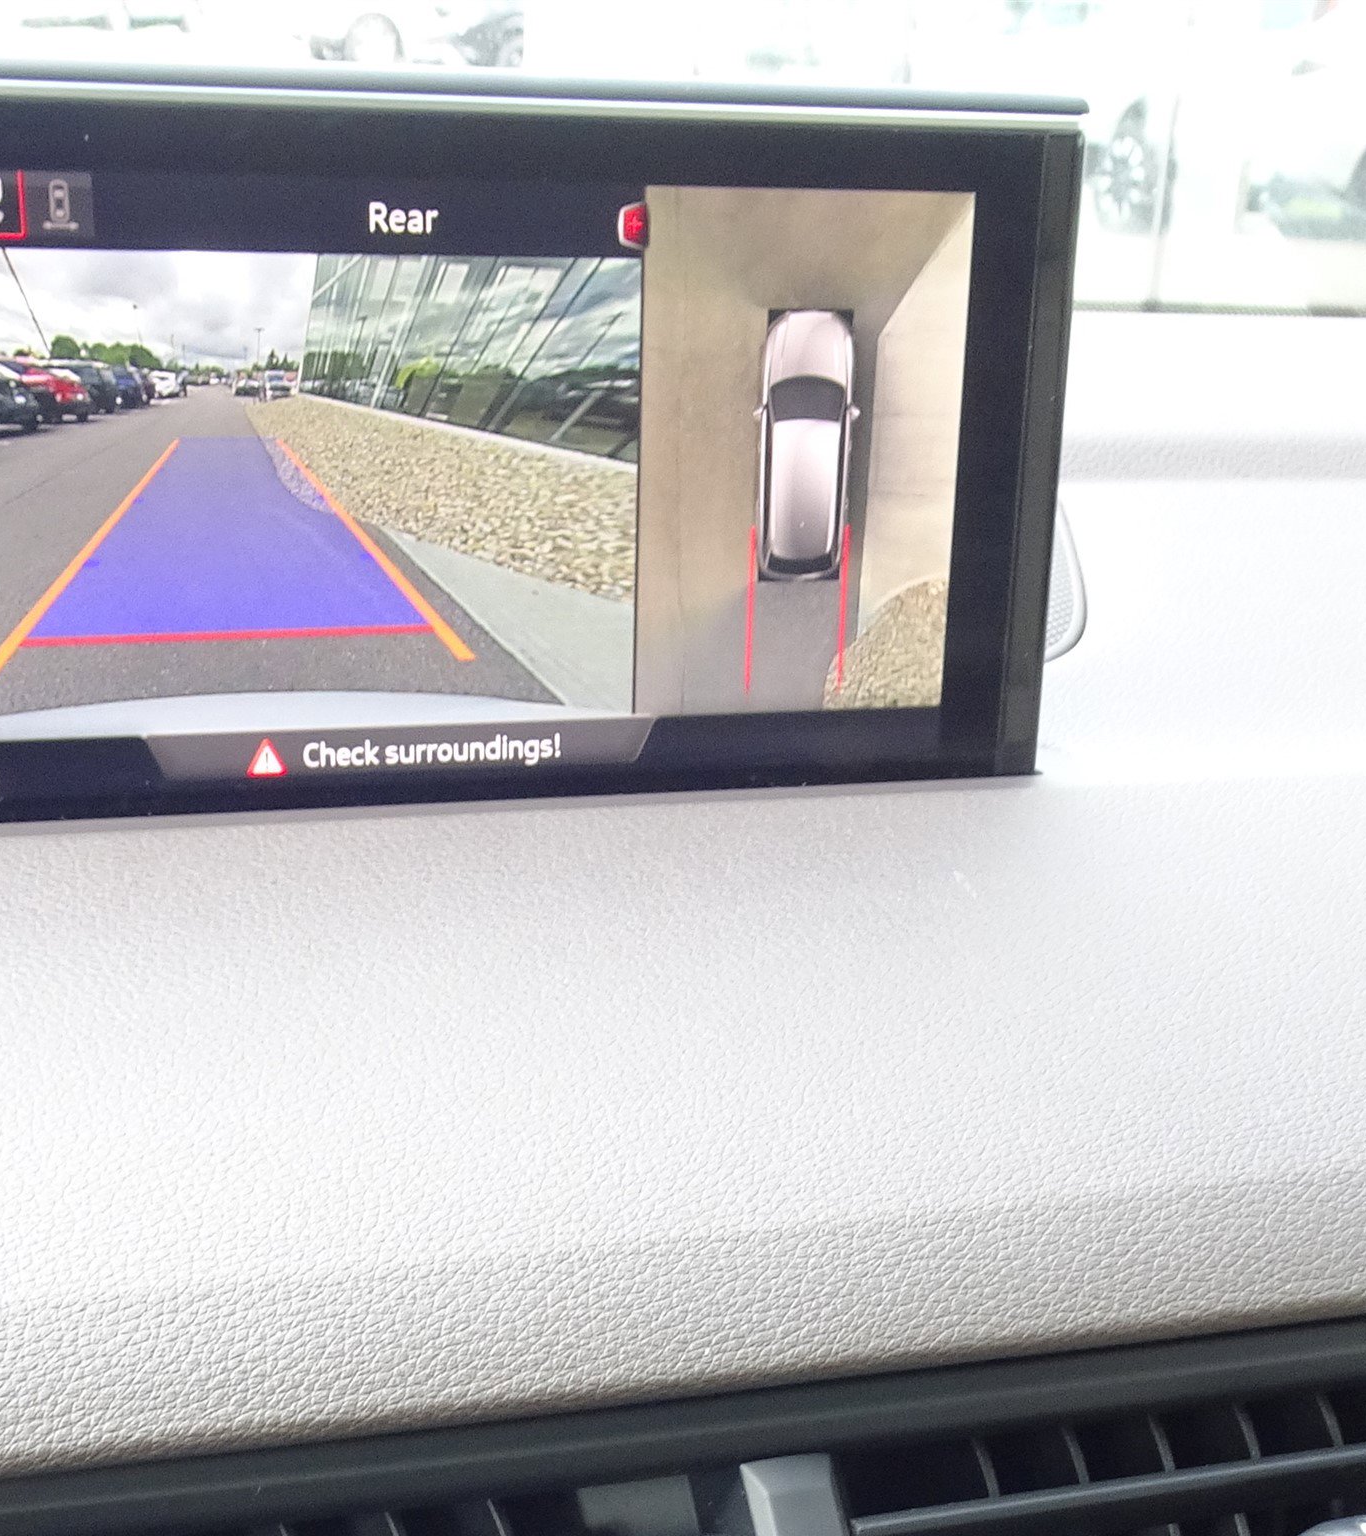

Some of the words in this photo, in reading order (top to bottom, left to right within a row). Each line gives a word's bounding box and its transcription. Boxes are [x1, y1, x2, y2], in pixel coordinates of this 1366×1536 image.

[367, 200, 440, 236] Rear
[302, 738, 379, 769] Check
[383, 731, 564, 768] surroundings!
